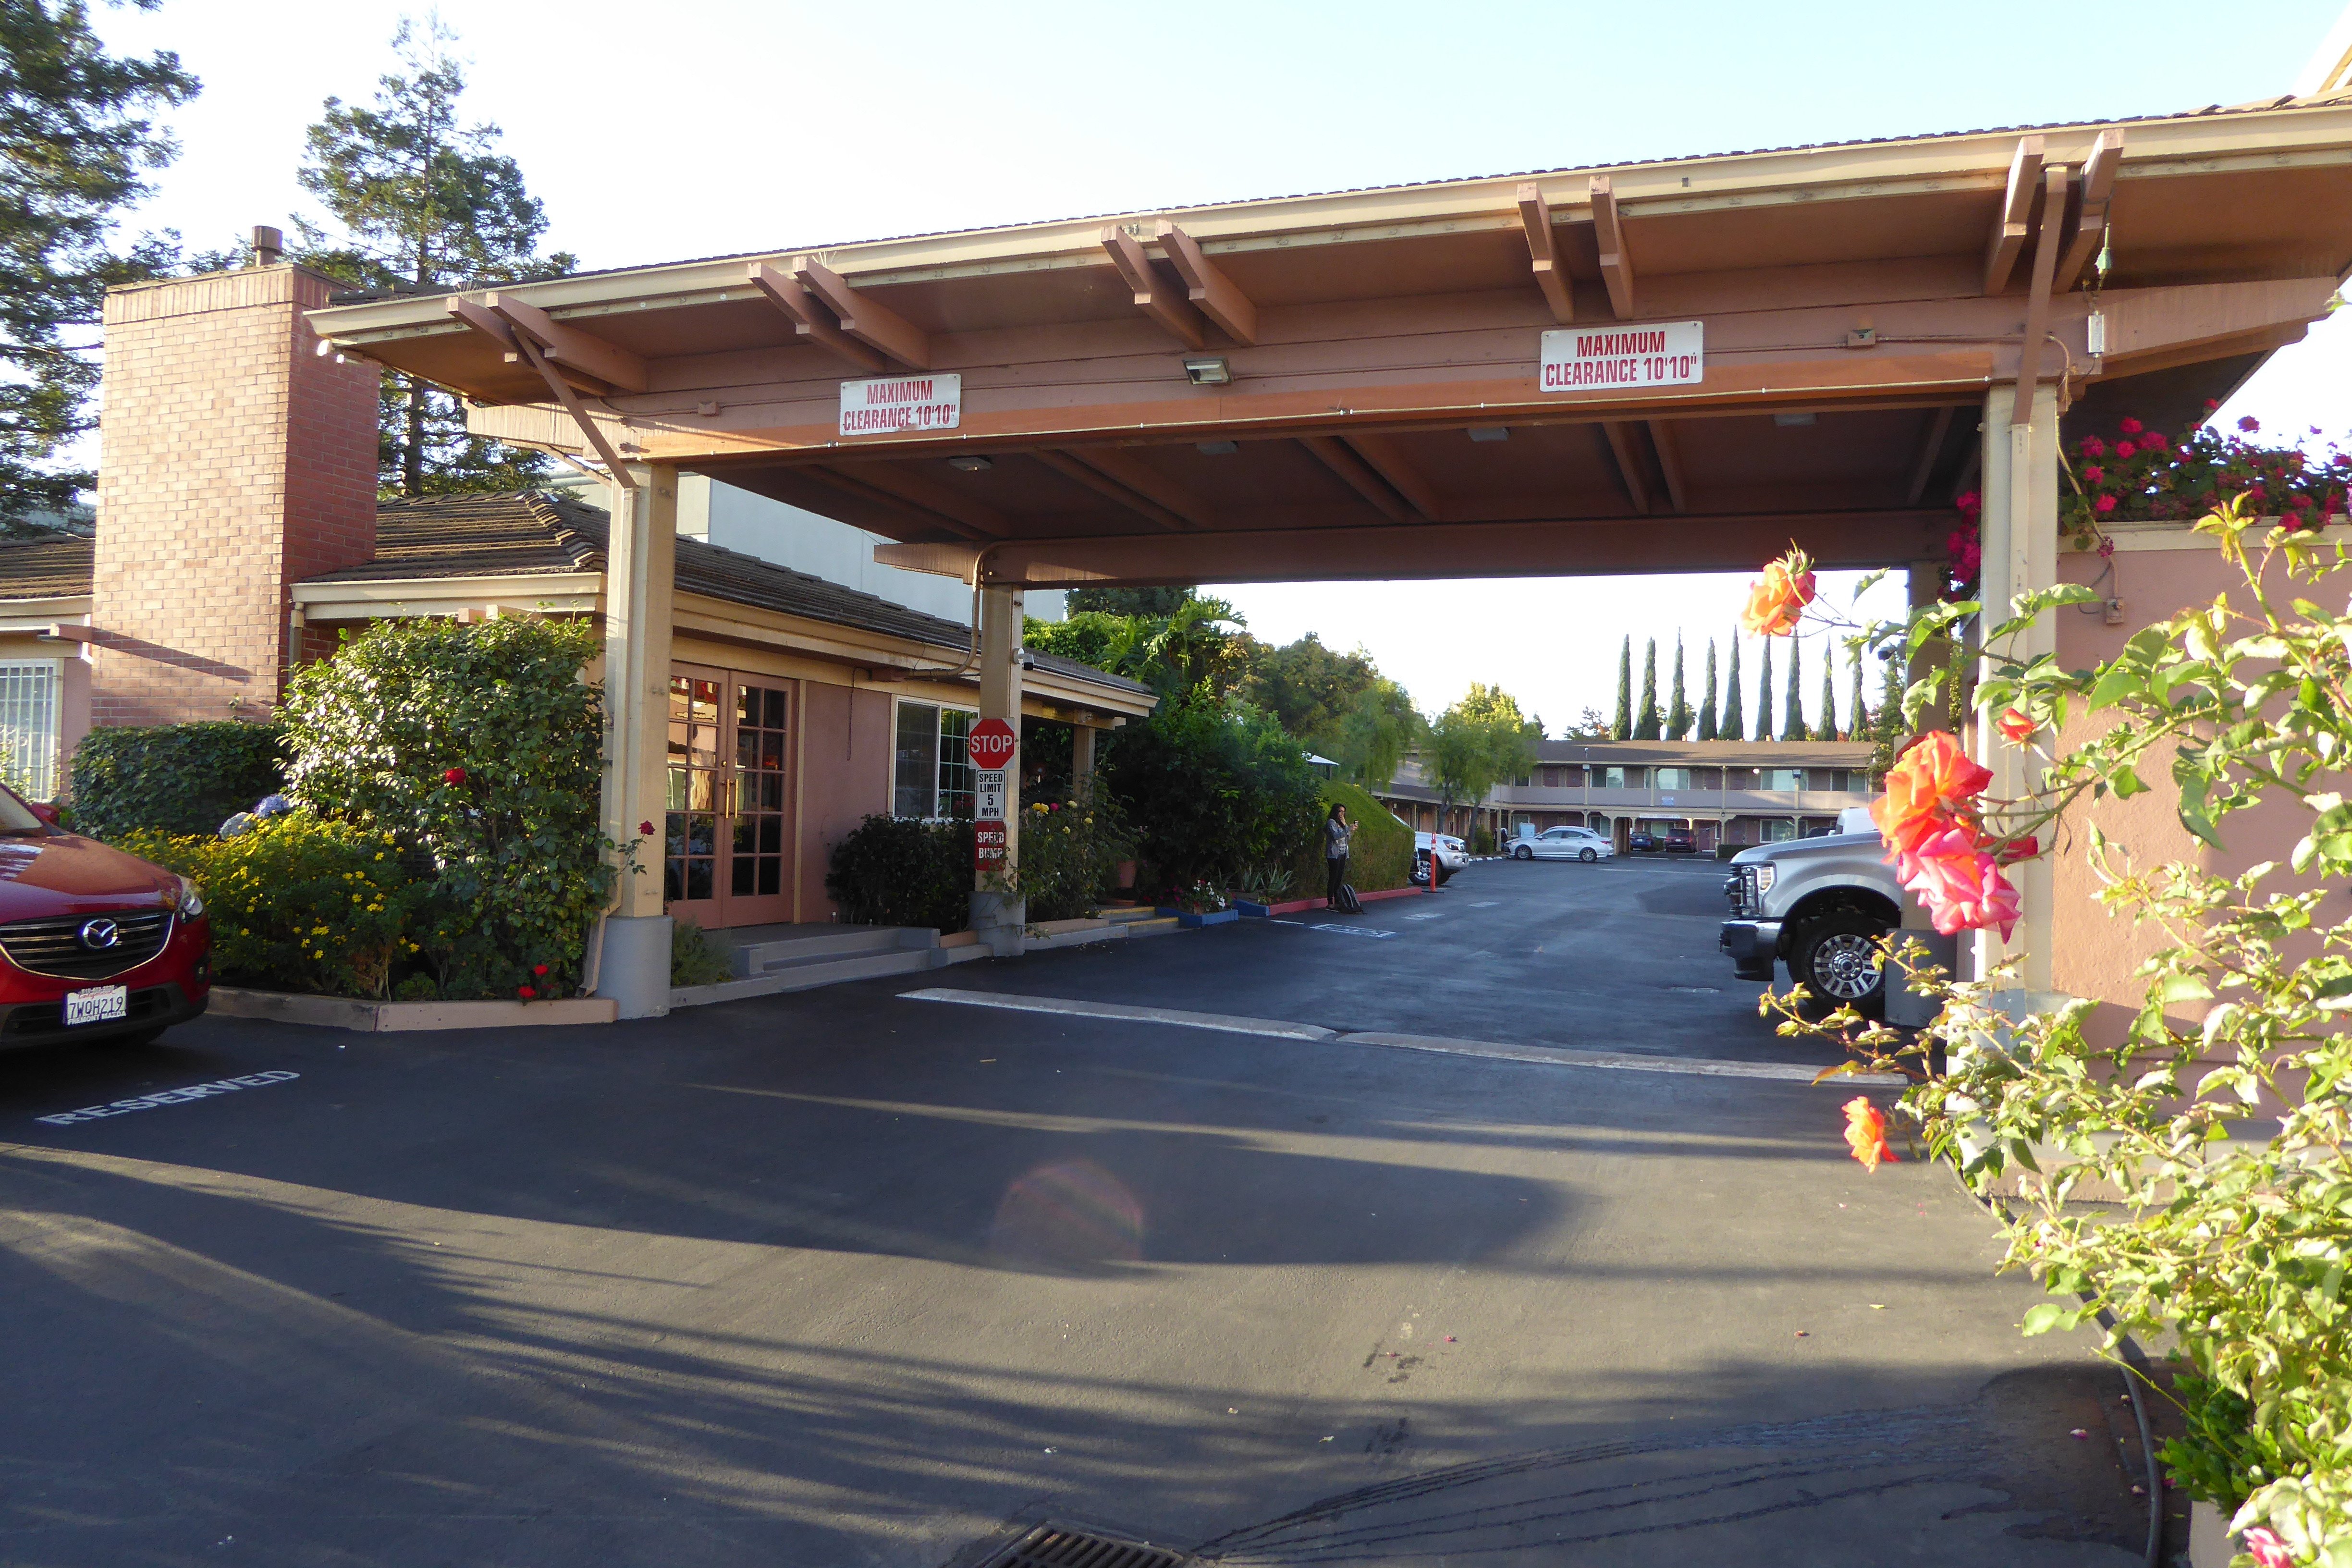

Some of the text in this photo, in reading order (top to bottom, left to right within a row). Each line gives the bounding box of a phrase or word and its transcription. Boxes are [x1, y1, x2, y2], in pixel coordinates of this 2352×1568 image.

[1577, 331, 1665, 357] MAXIMUM
[1545, 358, 1637, 386] CLEARANCE
[867, 380, 932, 404] MAXIMUM
[844, 407, 911, 431] CLEARANCE
[971, 735, 1013, 753] STOP
[979, 773, 1003, 783] SPEED
[980, 784, 1002, 793] LIMIT
[987, 794, 994, 806] 5
[982, 807, 999, 817] MPH
[977, 832, 1004, 844] SPEED
[68, 1011, 126, 1025] FREMONT MAZDA
[34, 1070, 301, 1125] RESERVED
